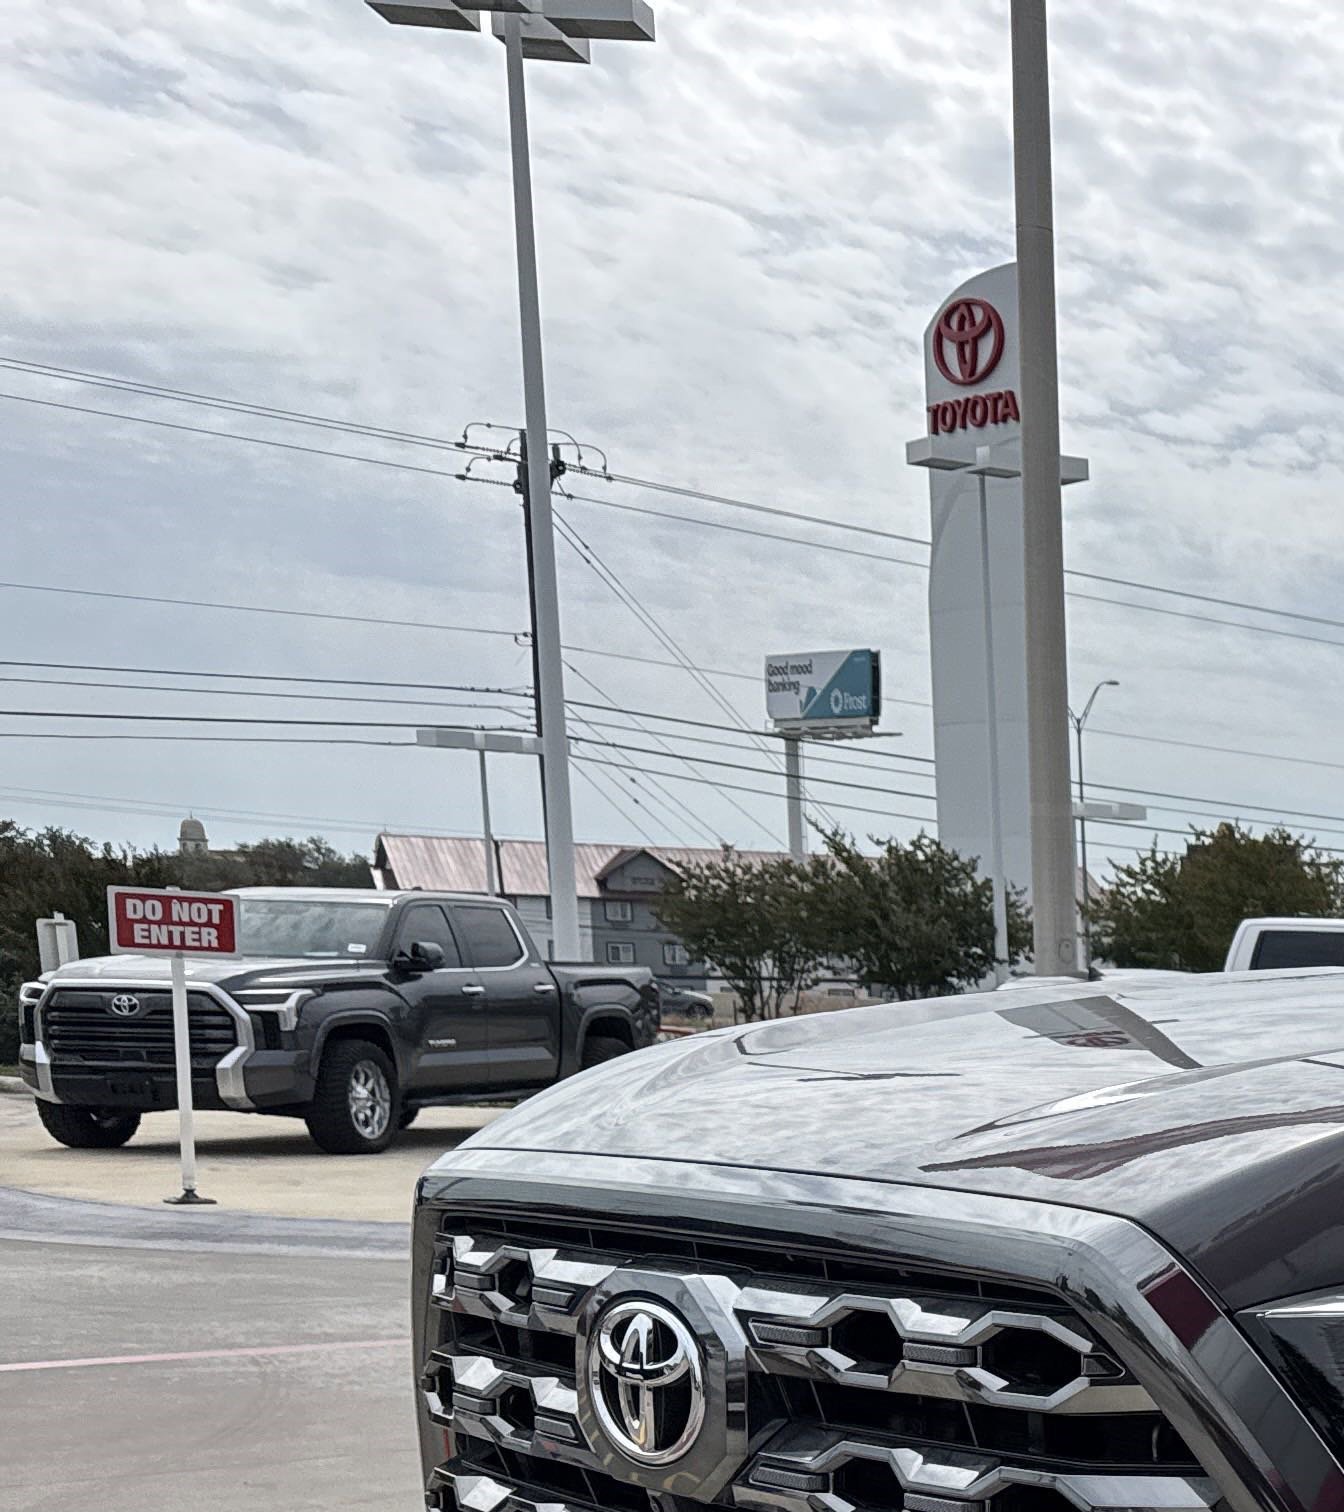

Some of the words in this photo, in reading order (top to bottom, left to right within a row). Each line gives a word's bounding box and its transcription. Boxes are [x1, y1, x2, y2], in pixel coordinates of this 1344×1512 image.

[927, 390, 1020, 435] TOYOTA
[767, 661, 788, 677] Good
[790, 659, 813, 675] mood
[768, 676, 800, 695] banking
[844, 692, 867, 711] Frost
[125, 898, 163, 921] DO
[171, 899, 224, 924] NOT
[133, 924, 220, 948] ENTER
